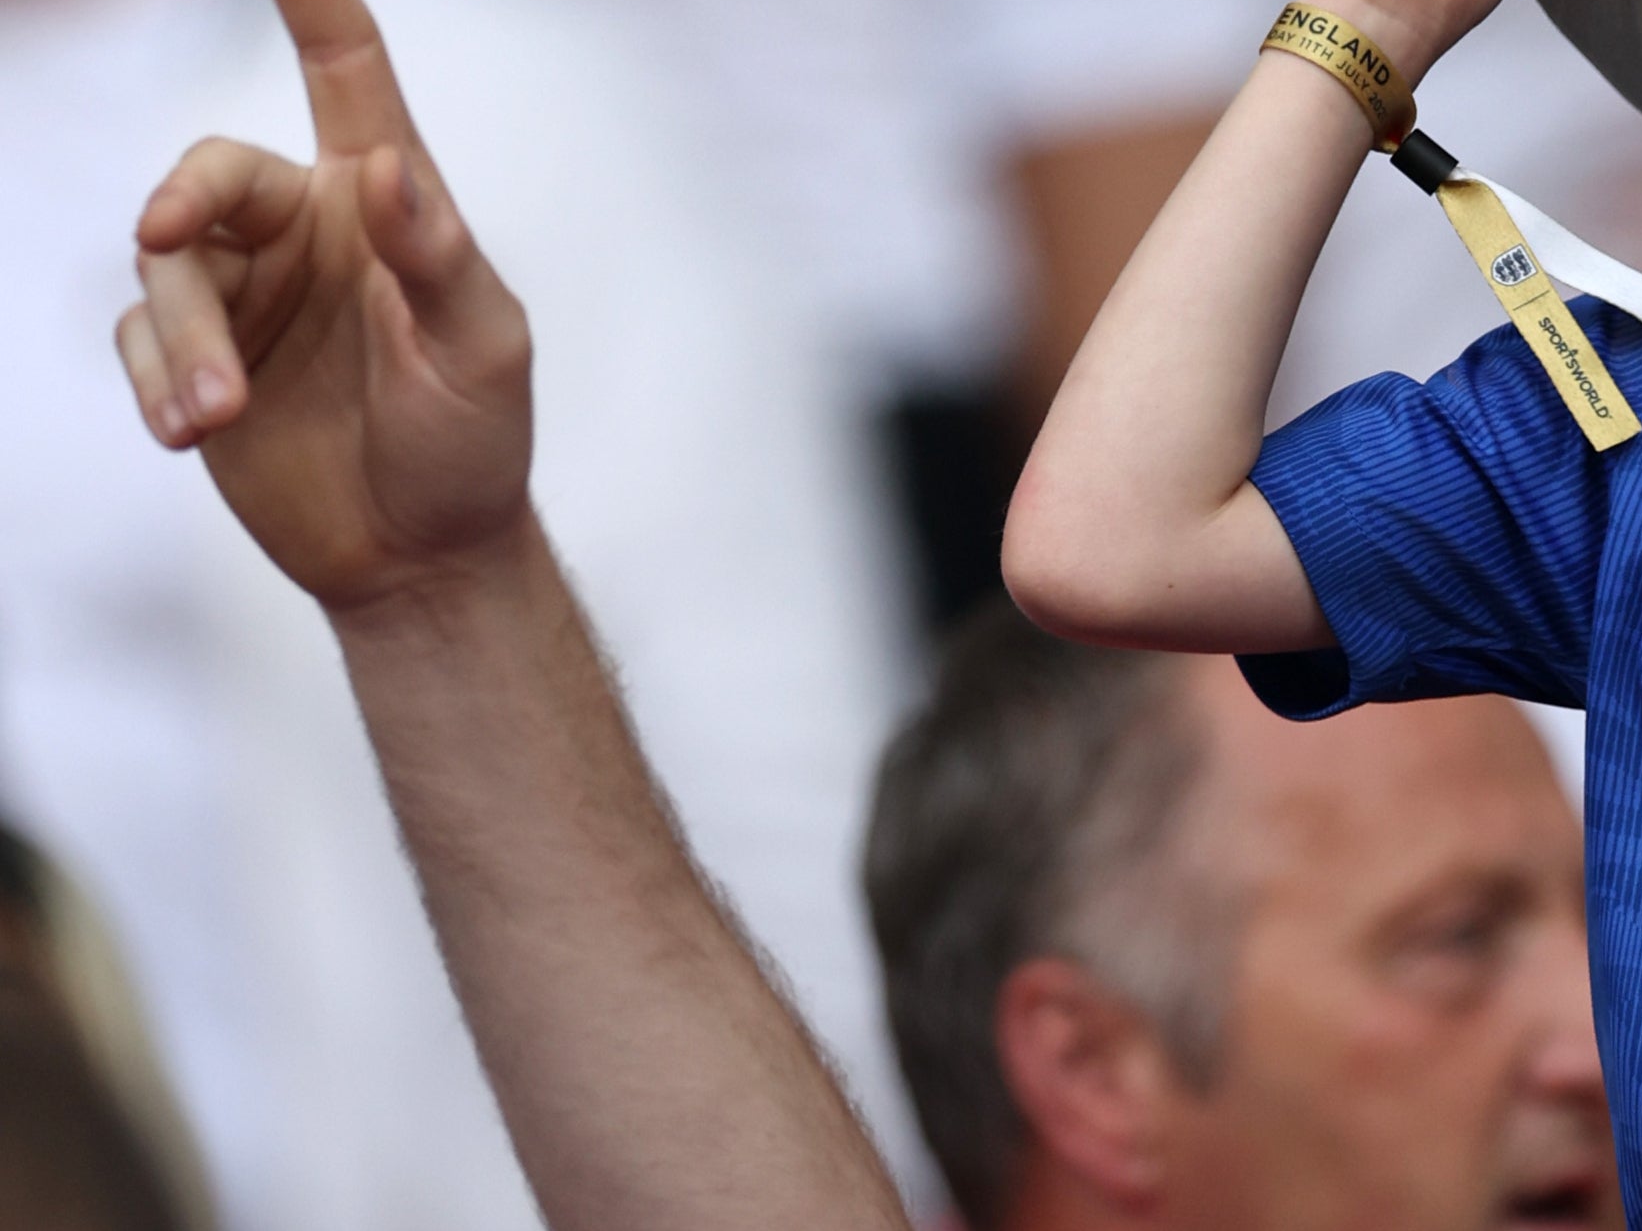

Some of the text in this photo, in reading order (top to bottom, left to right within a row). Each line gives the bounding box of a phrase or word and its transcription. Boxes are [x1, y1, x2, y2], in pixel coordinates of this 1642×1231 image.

[1278, 8, 1390, 86] ENGLAND
[1299, 37, 1334, 61] 11TH
[1336, 60, 1370, 91] JULY
[1538, 316, 1608, 419] SPORTSWORLD
